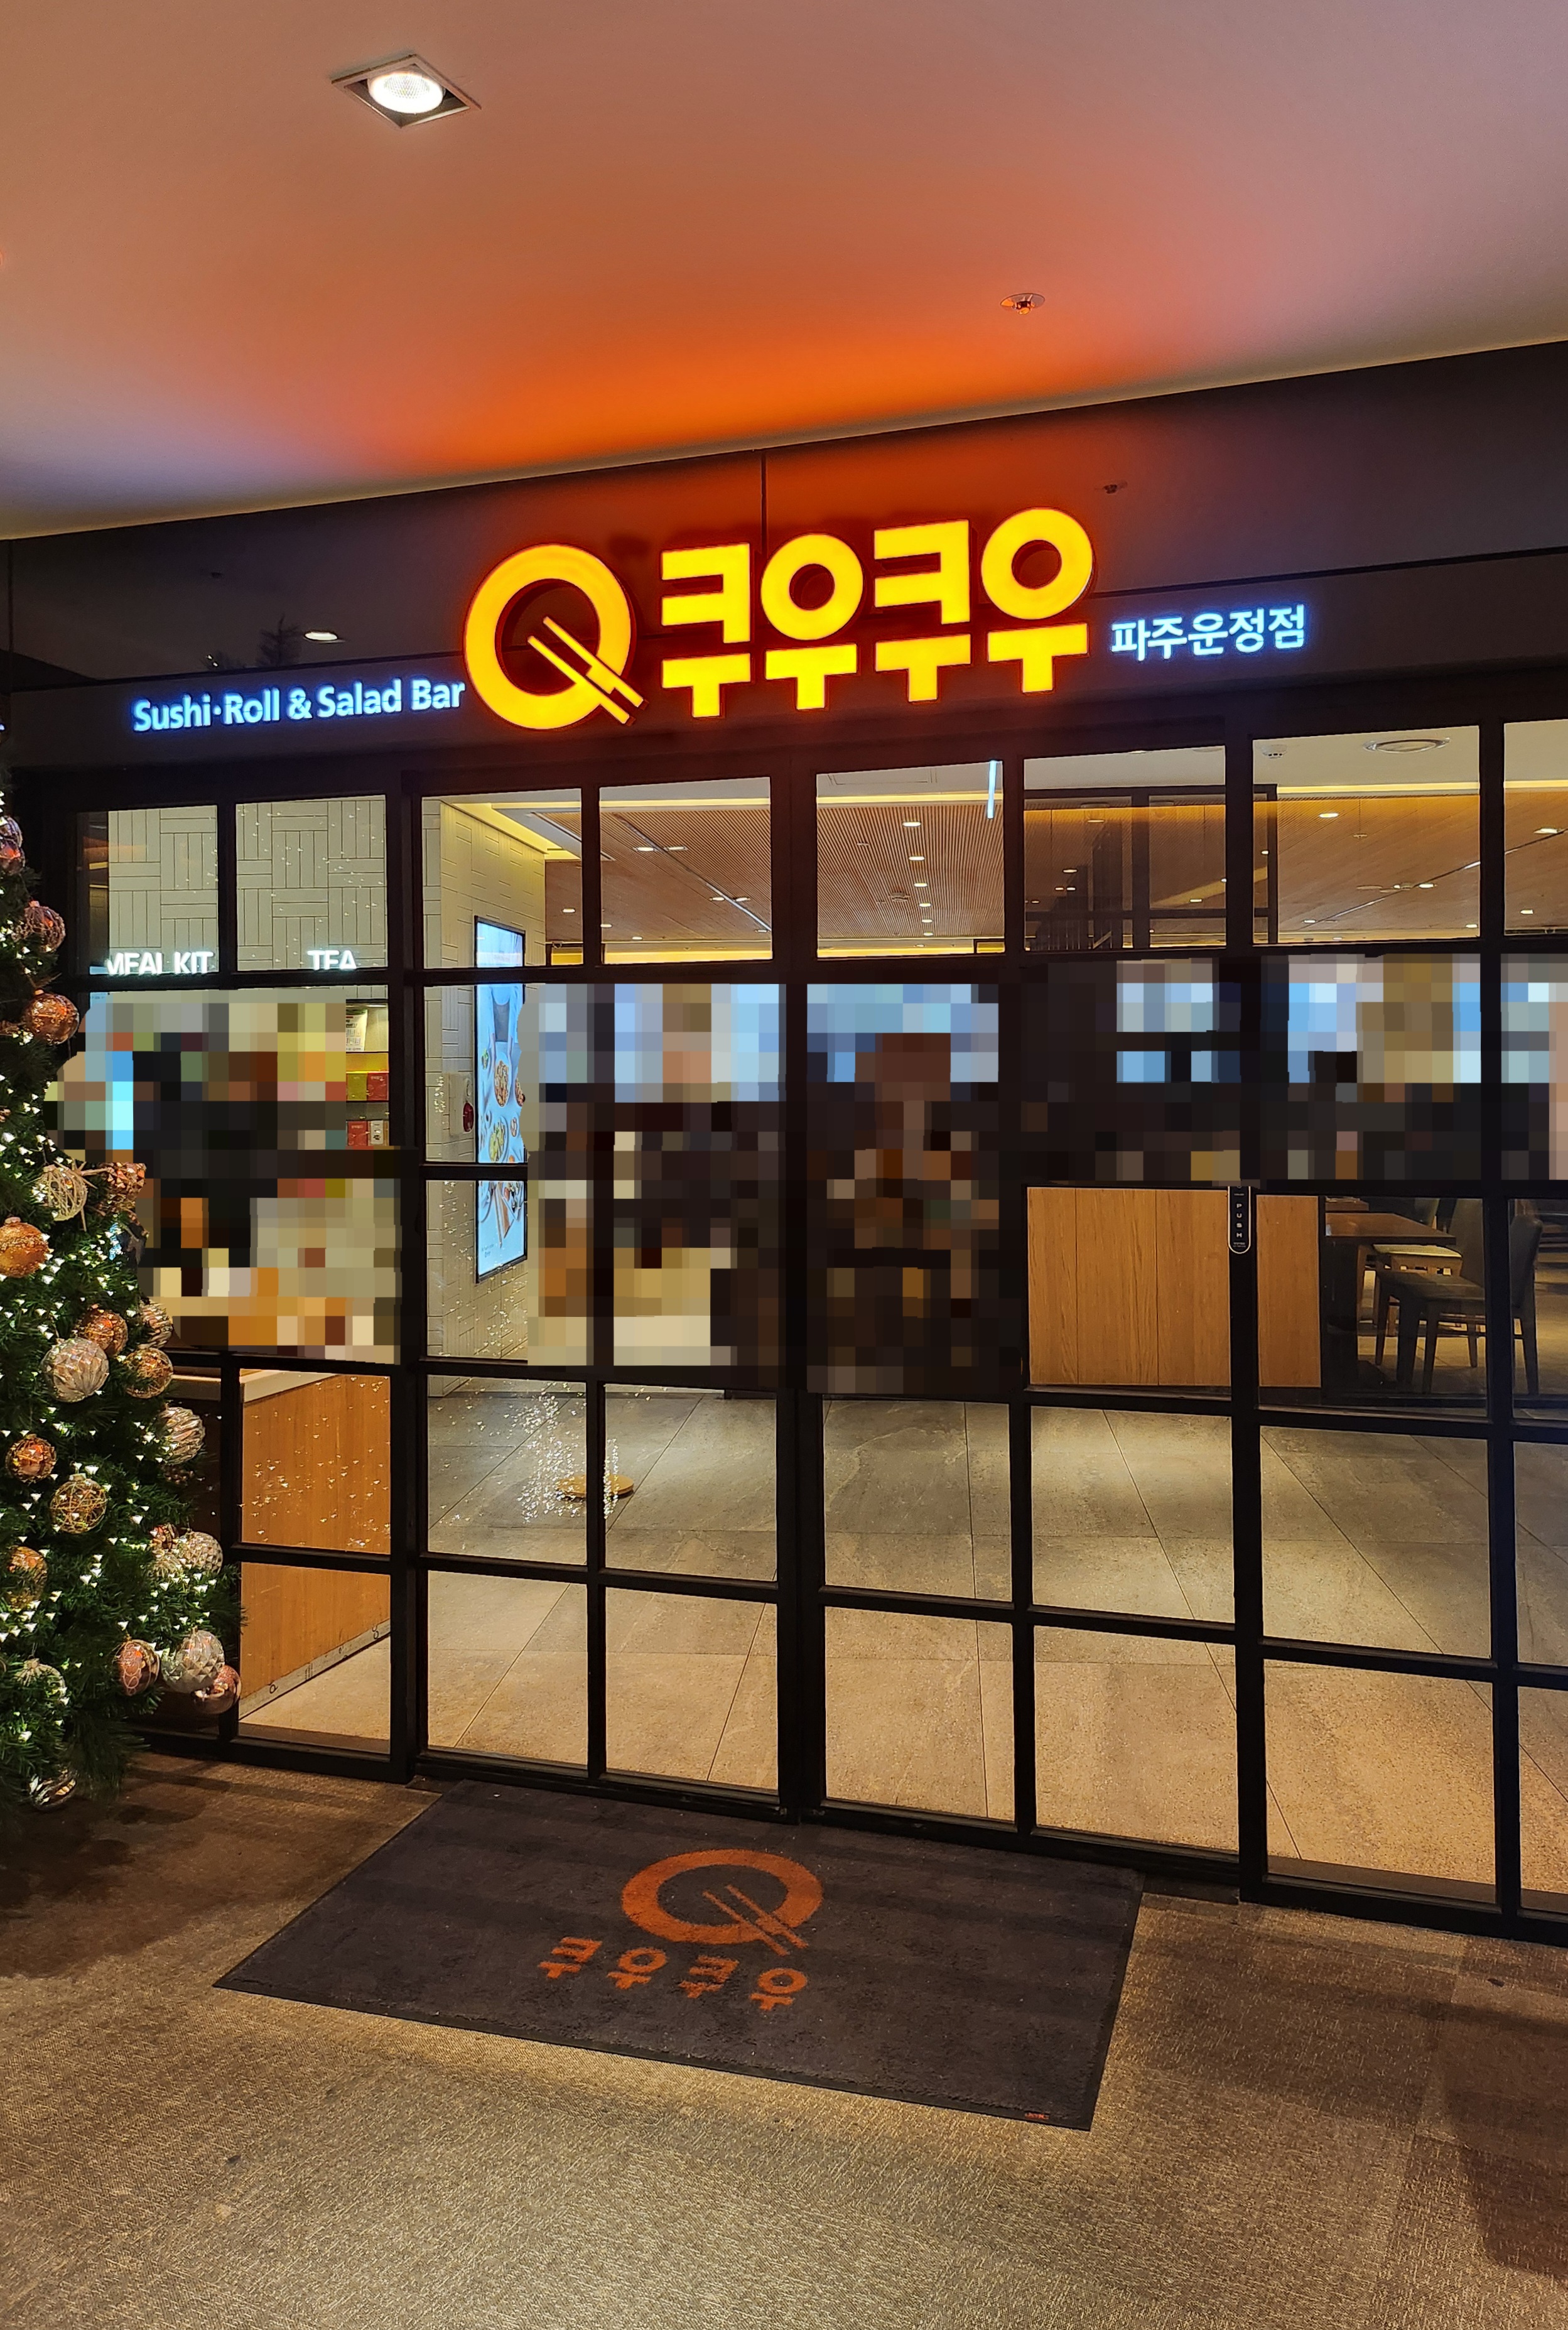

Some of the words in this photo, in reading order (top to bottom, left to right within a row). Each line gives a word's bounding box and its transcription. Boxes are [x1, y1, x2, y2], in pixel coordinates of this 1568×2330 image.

[661, 508, 1094, 718] 쿠우쿠우
[1111, 604, 1305, 661] 파주운정점
[288, 687, 313, 720] &
[317, 678, 402, 718] Salad
[411, 679, 465, 710] Bar
[173, 951, 214, 975] KIT
[538, 1936, 808, 2011] 쿠우쿠우
